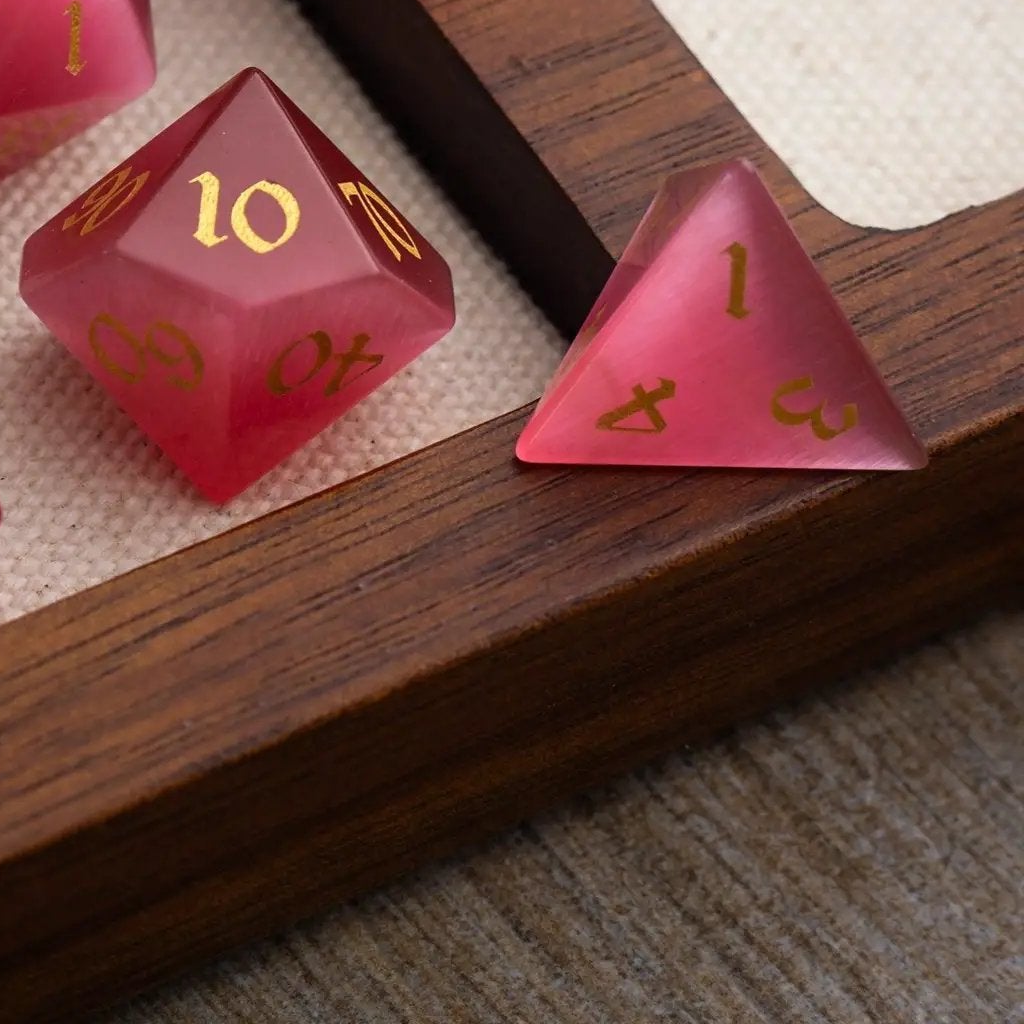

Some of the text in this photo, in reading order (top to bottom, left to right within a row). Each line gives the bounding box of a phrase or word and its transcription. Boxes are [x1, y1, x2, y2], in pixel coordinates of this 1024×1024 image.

[62, 0, 88, 76] 1
[188, 170, 301, 255] 10
[337, 181, 423, 262] 70
[719, 240, 751, 320] 1
[266, 329, 385, 399] 40
[595, 377, 677, 435] 4
[770, 375, 859, 442] 3
